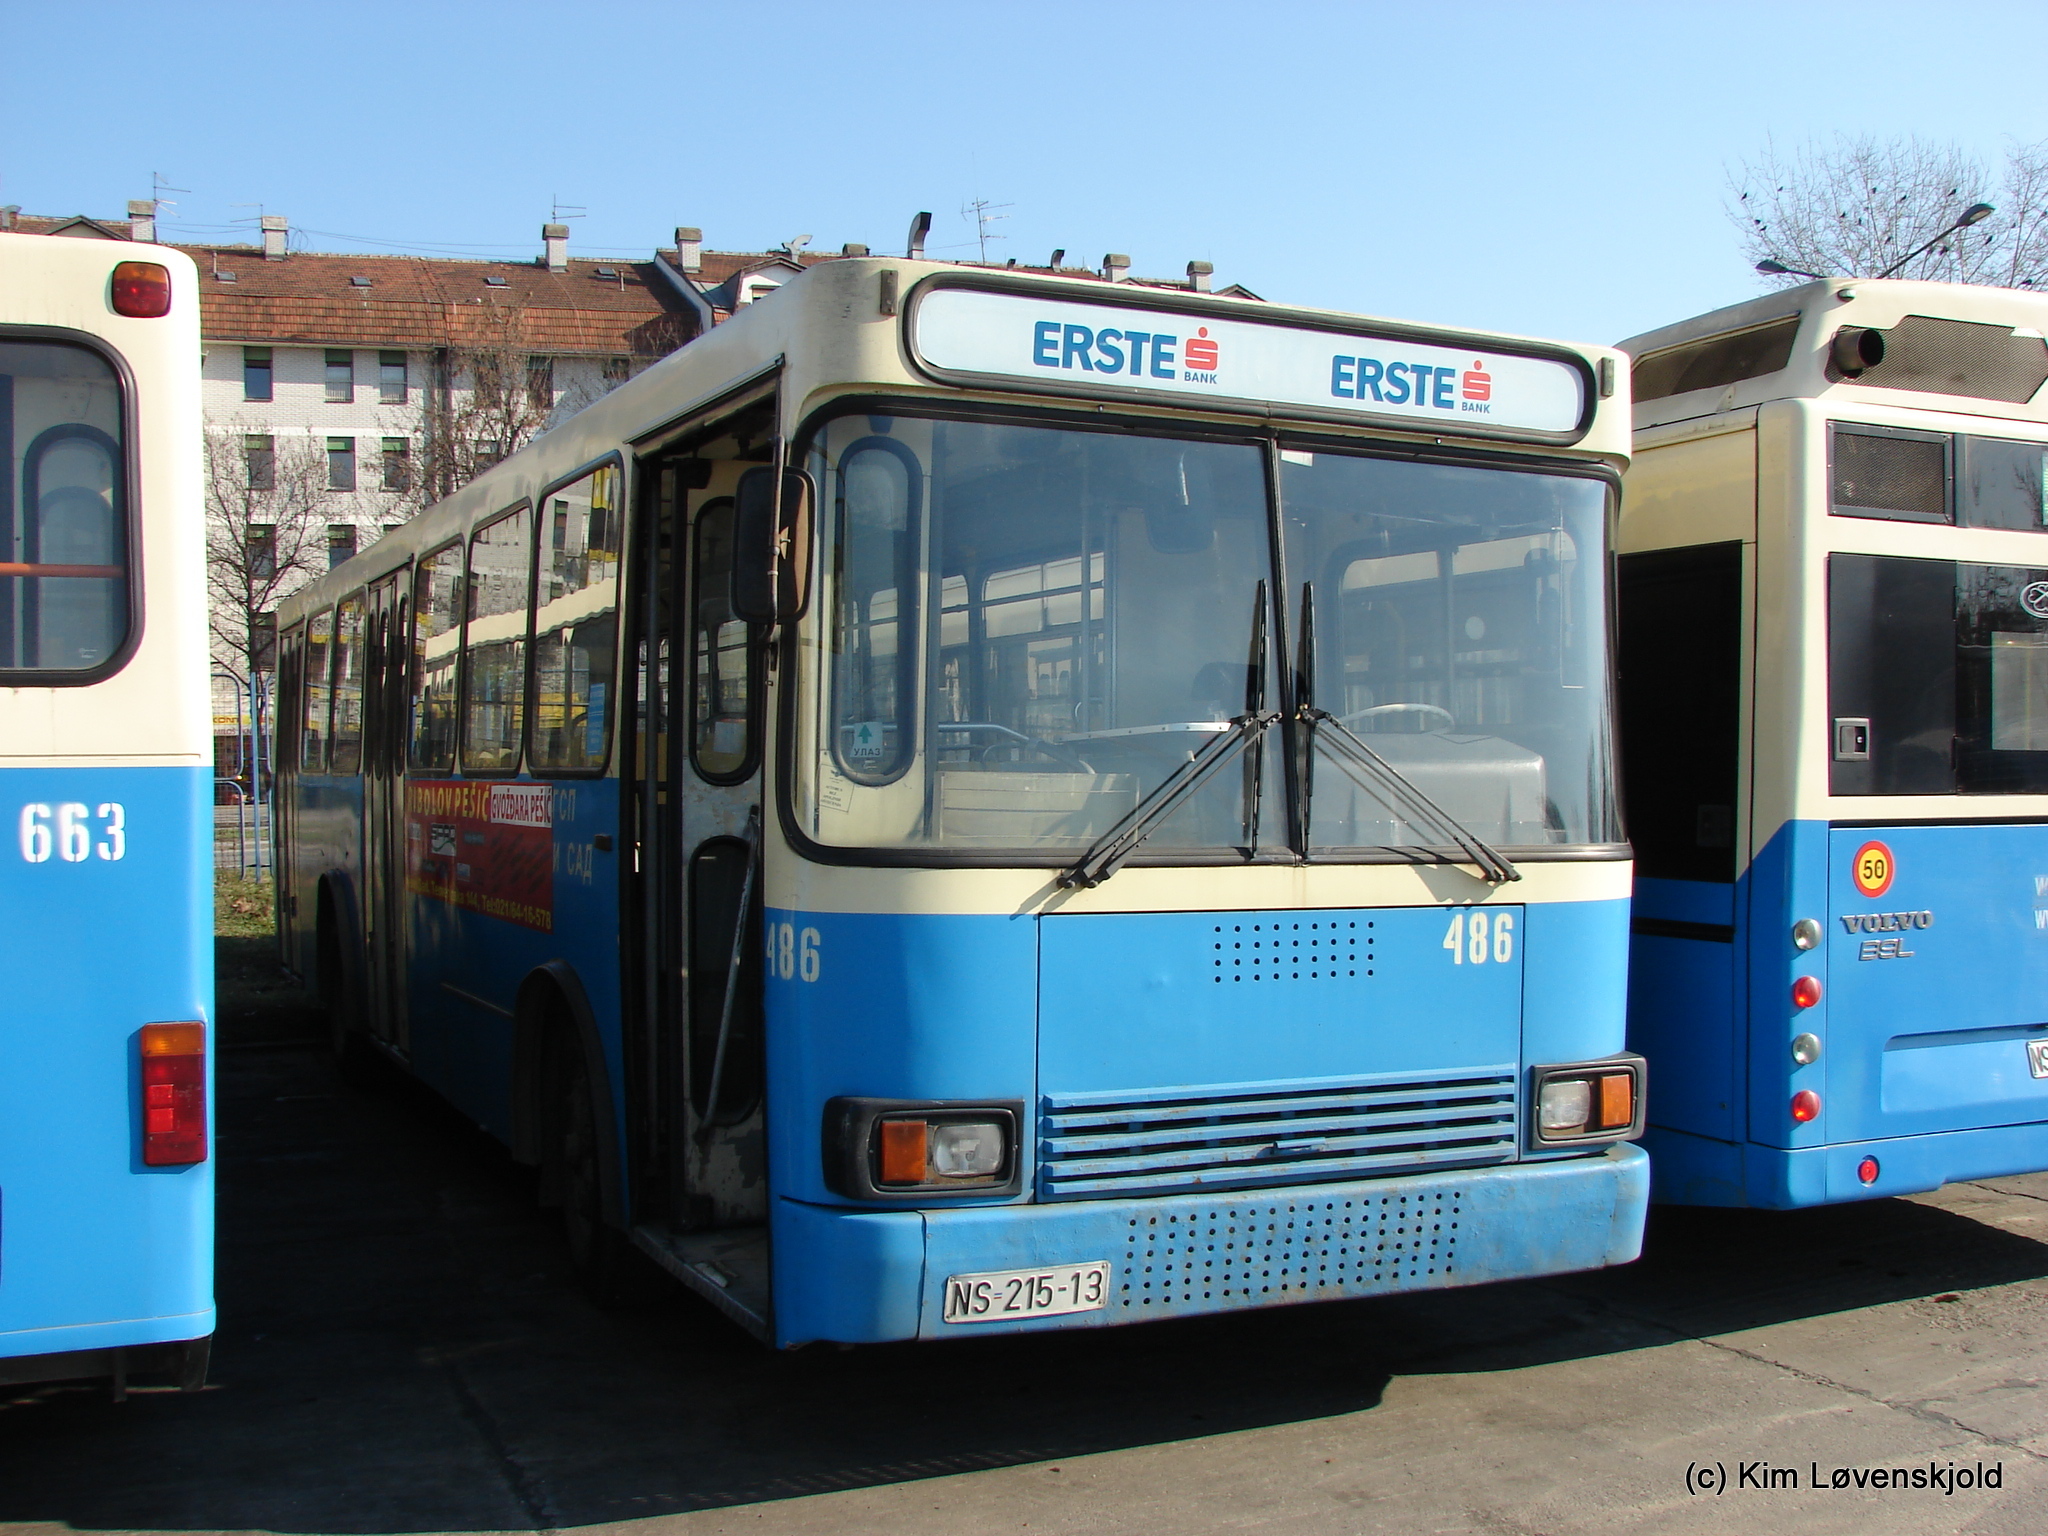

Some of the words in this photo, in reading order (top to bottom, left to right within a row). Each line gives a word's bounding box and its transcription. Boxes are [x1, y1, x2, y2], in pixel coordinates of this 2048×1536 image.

[1032, 320, 1177, 379] ERSTE
[1183, 371, 1218, 385] BANK
[1330, 354, 1456, 409] ERSTE
[1461, 402, 1491, 414] BANK
[853, 747, 881, 756] УЛАЗ
[454, 781, 489, 822] PEŠIĆ
[530, 787, 552, 824] PEŠIĆ
[20, 802, 127, 863] 663
[567, 842, 593, 886] САД
[1862, 859, 1885, 880] 50
[1442, 912, 1513, 965] 486
[1841, 910, 1934, 934] VOLVO
[766, 922, 821, 982] 486
